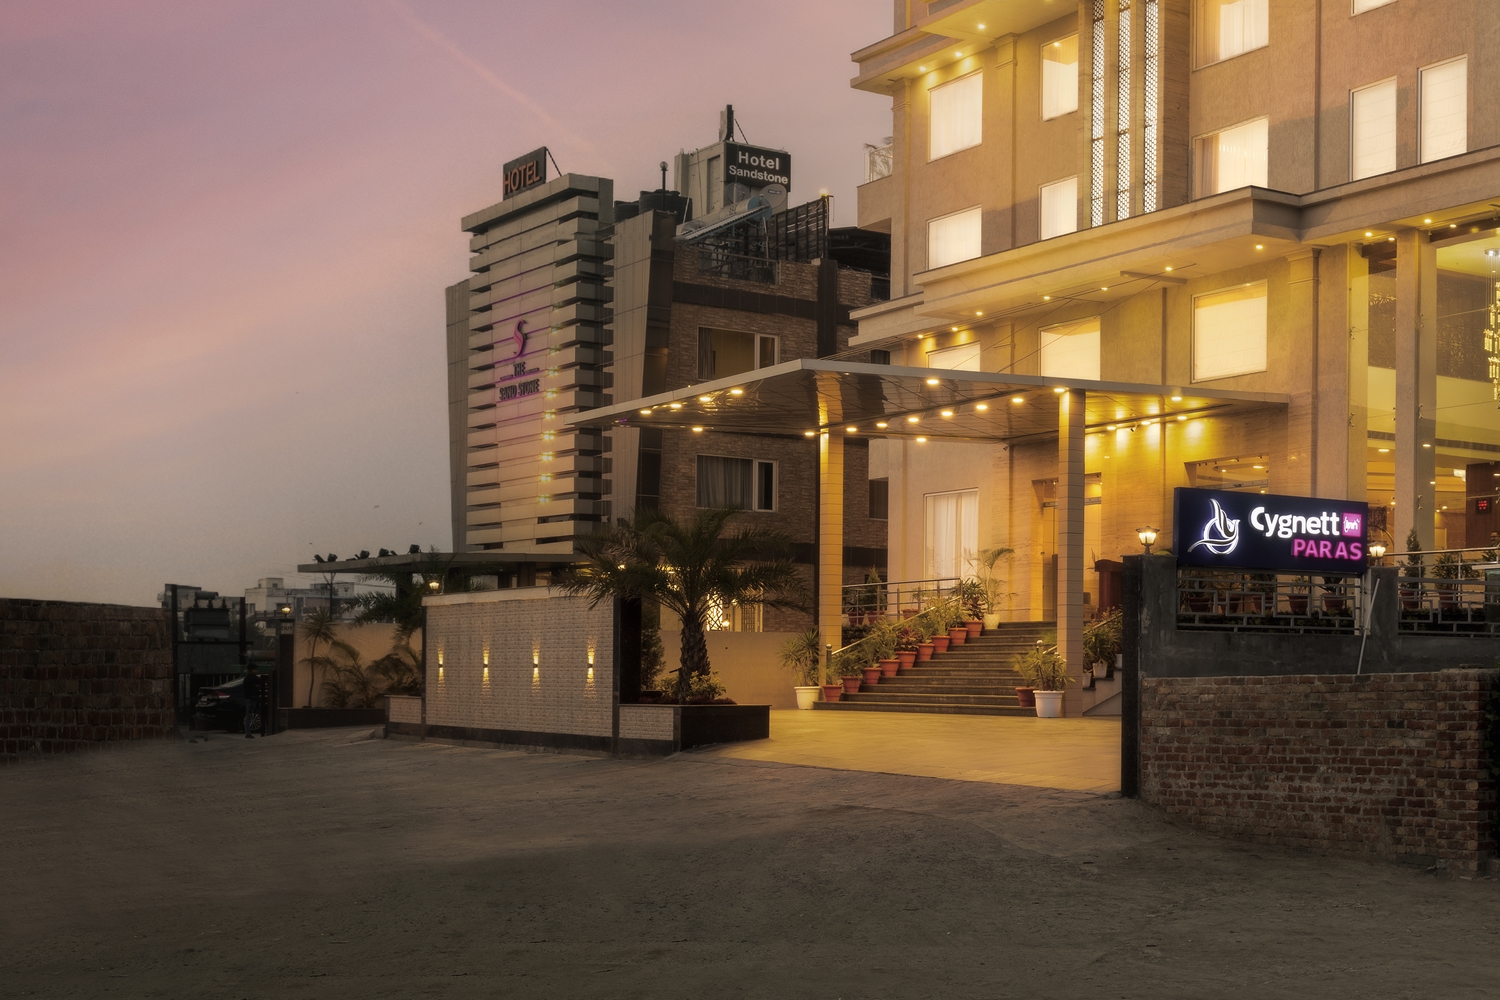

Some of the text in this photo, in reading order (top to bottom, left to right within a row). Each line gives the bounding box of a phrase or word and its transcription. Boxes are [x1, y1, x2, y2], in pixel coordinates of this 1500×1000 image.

[738, 150, 780, 170] Hotel
[503, 160, 540, 195] HOTEL
[728, 165, 789, 185] Sandstone
[513, 361, 526, 377] THE
[499, 379, 540, 400] SAND STONE
[1250, 506, 1340, 539] Cygnett
[1293, 539, 1362, 560] PARAS
